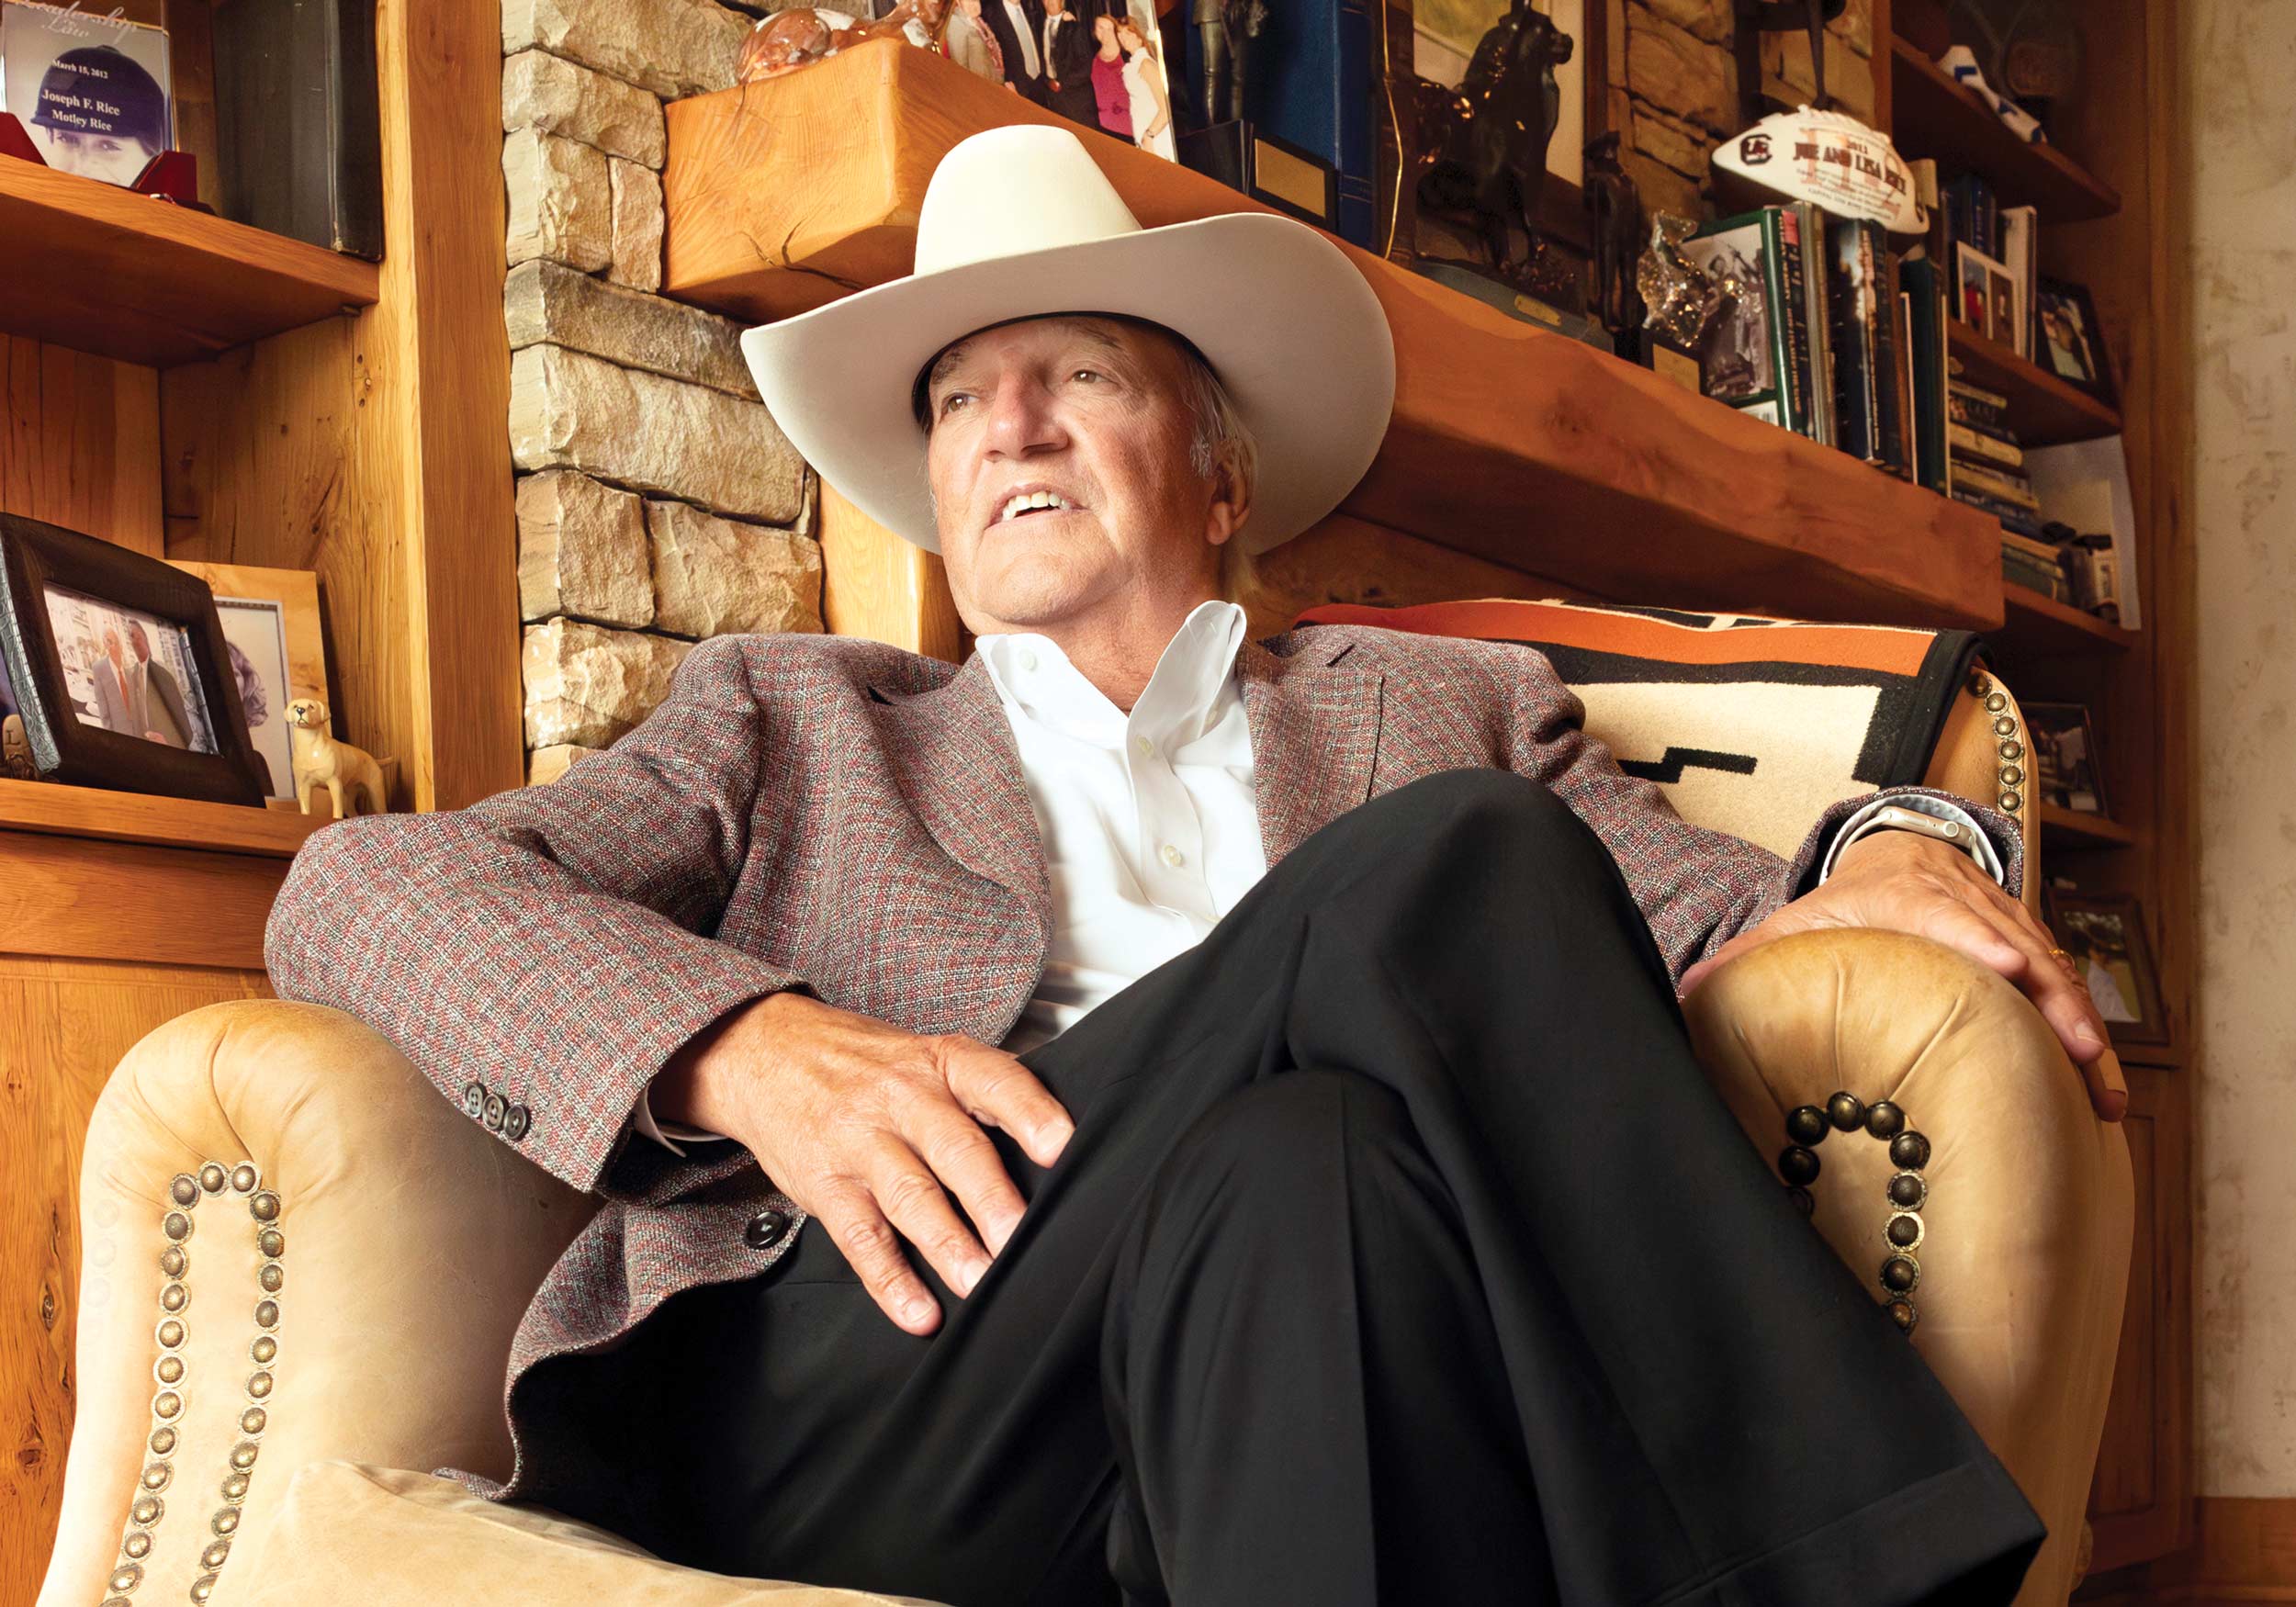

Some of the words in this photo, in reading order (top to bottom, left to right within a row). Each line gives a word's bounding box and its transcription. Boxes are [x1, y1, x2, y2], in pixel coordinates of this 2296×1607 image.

[41, 15, 89, 38] Law
[51, 59, 77, 73] March
[41, 89, 80, 107] Joseph
[83, 97, 93, 109] F.
[96, 101, 121, 116] Rice
[51, 109, 87, 128] Motley
[90, 118, 112, 131] Rice
